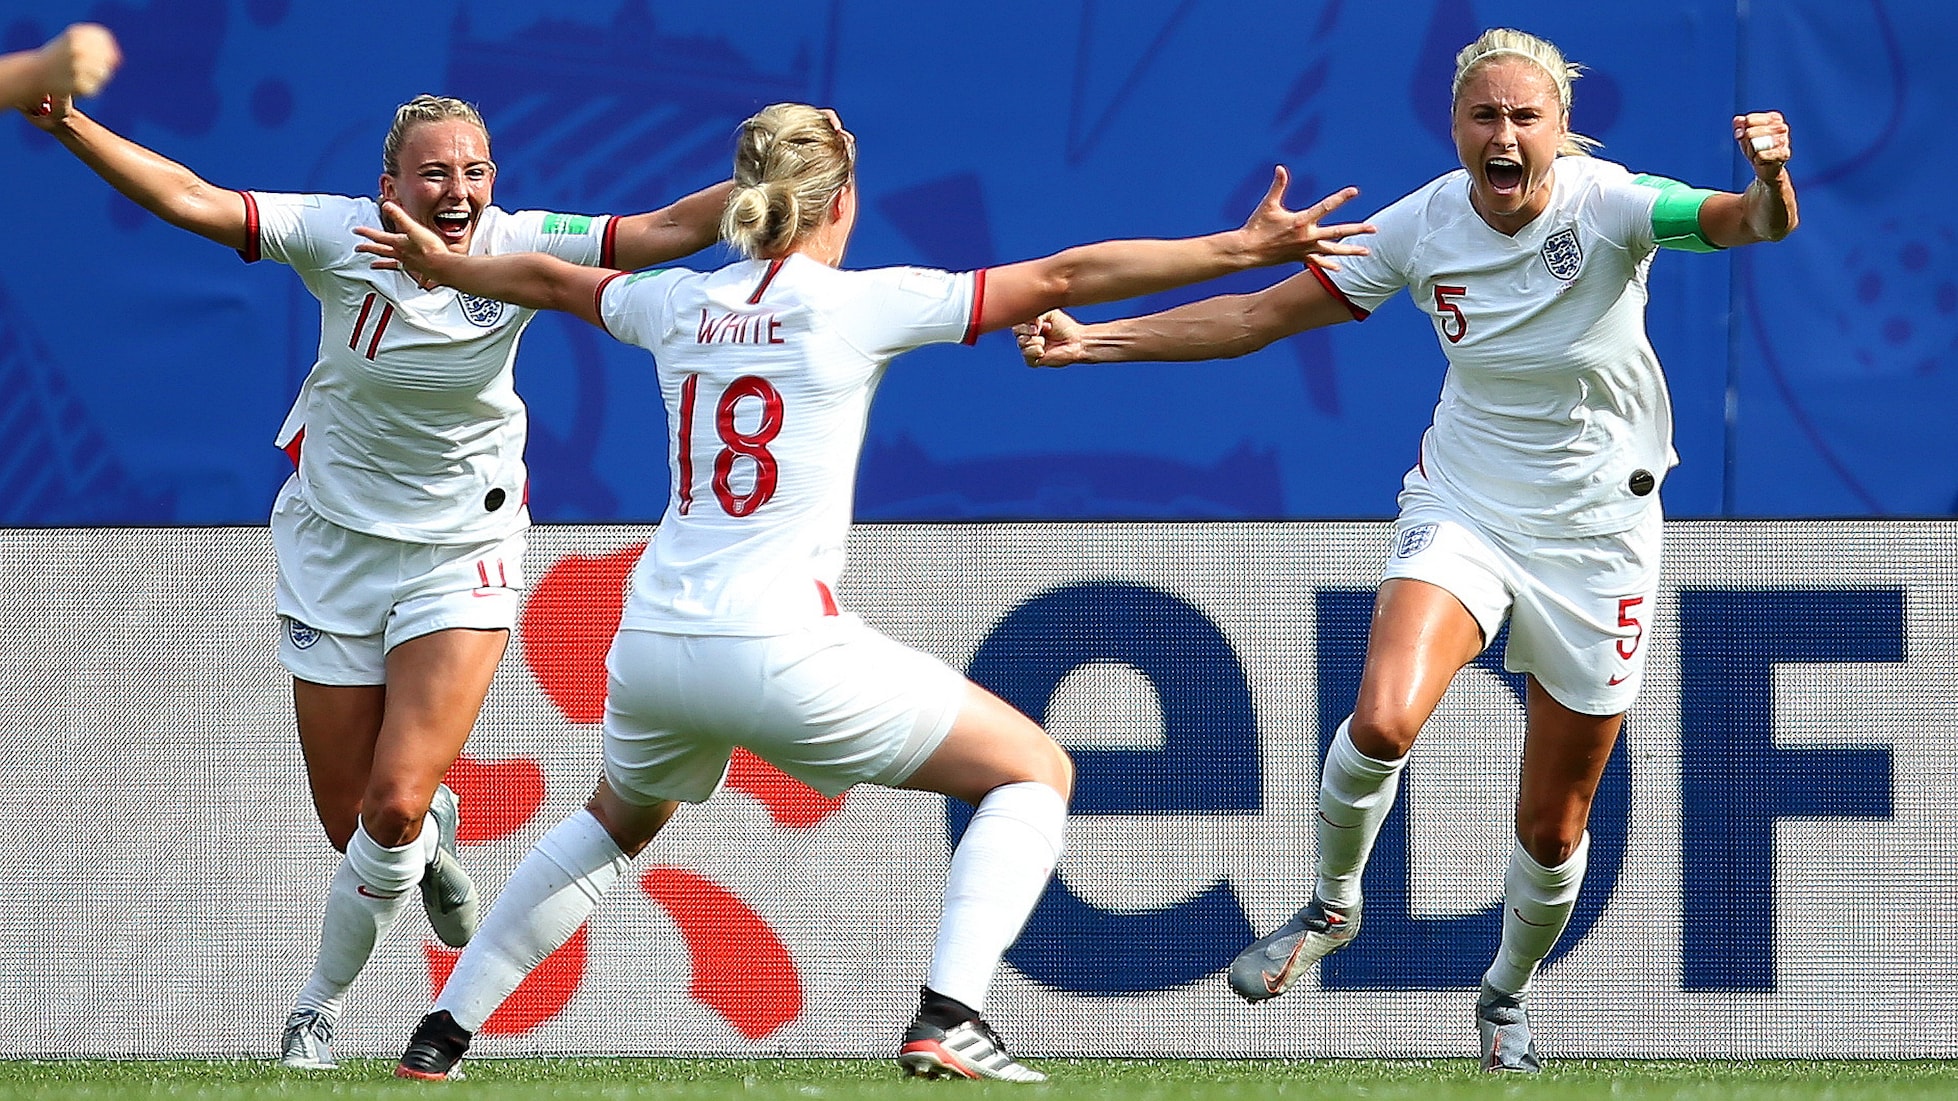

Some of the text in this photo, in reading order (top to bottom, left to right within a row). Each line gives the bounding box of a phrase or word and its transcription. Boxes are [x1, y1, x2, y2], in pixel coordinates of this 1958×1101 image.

[347, 291, 396, 362] 11
[696, 309, 785, 344] WHITE
[1433, 284, 1468, 343] 5
[677, 372, 784, 518] 18
[476, 558, 507, 587] 11
[1615, 596, 1643, 660] 5
